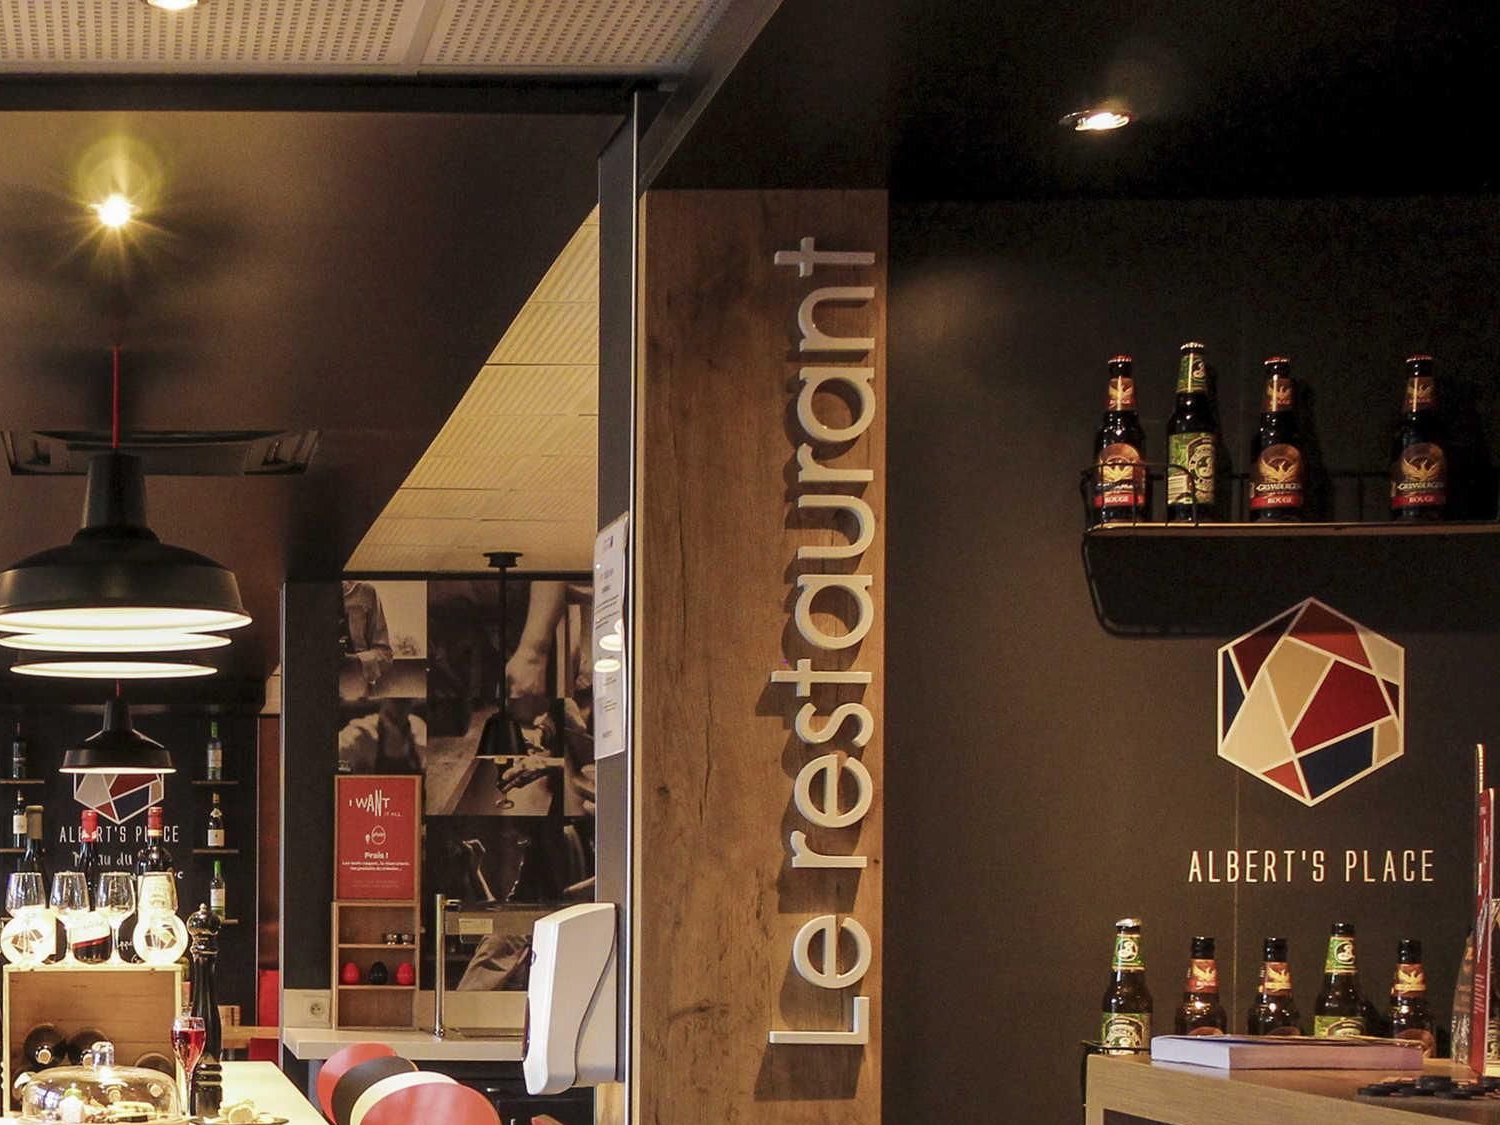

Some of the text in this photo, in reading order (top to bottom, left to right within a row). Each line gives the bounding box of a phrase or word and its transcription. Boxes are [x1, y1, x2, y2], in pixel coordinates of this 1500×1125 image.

[768, 236, 876, 1046] Le restaurant
[355, 789, 391, 816] WANT
[59, 825, 179, 843] ALRT'S PLCE
[1188, 849, 1436, 883] ALBERT'S PLACE
